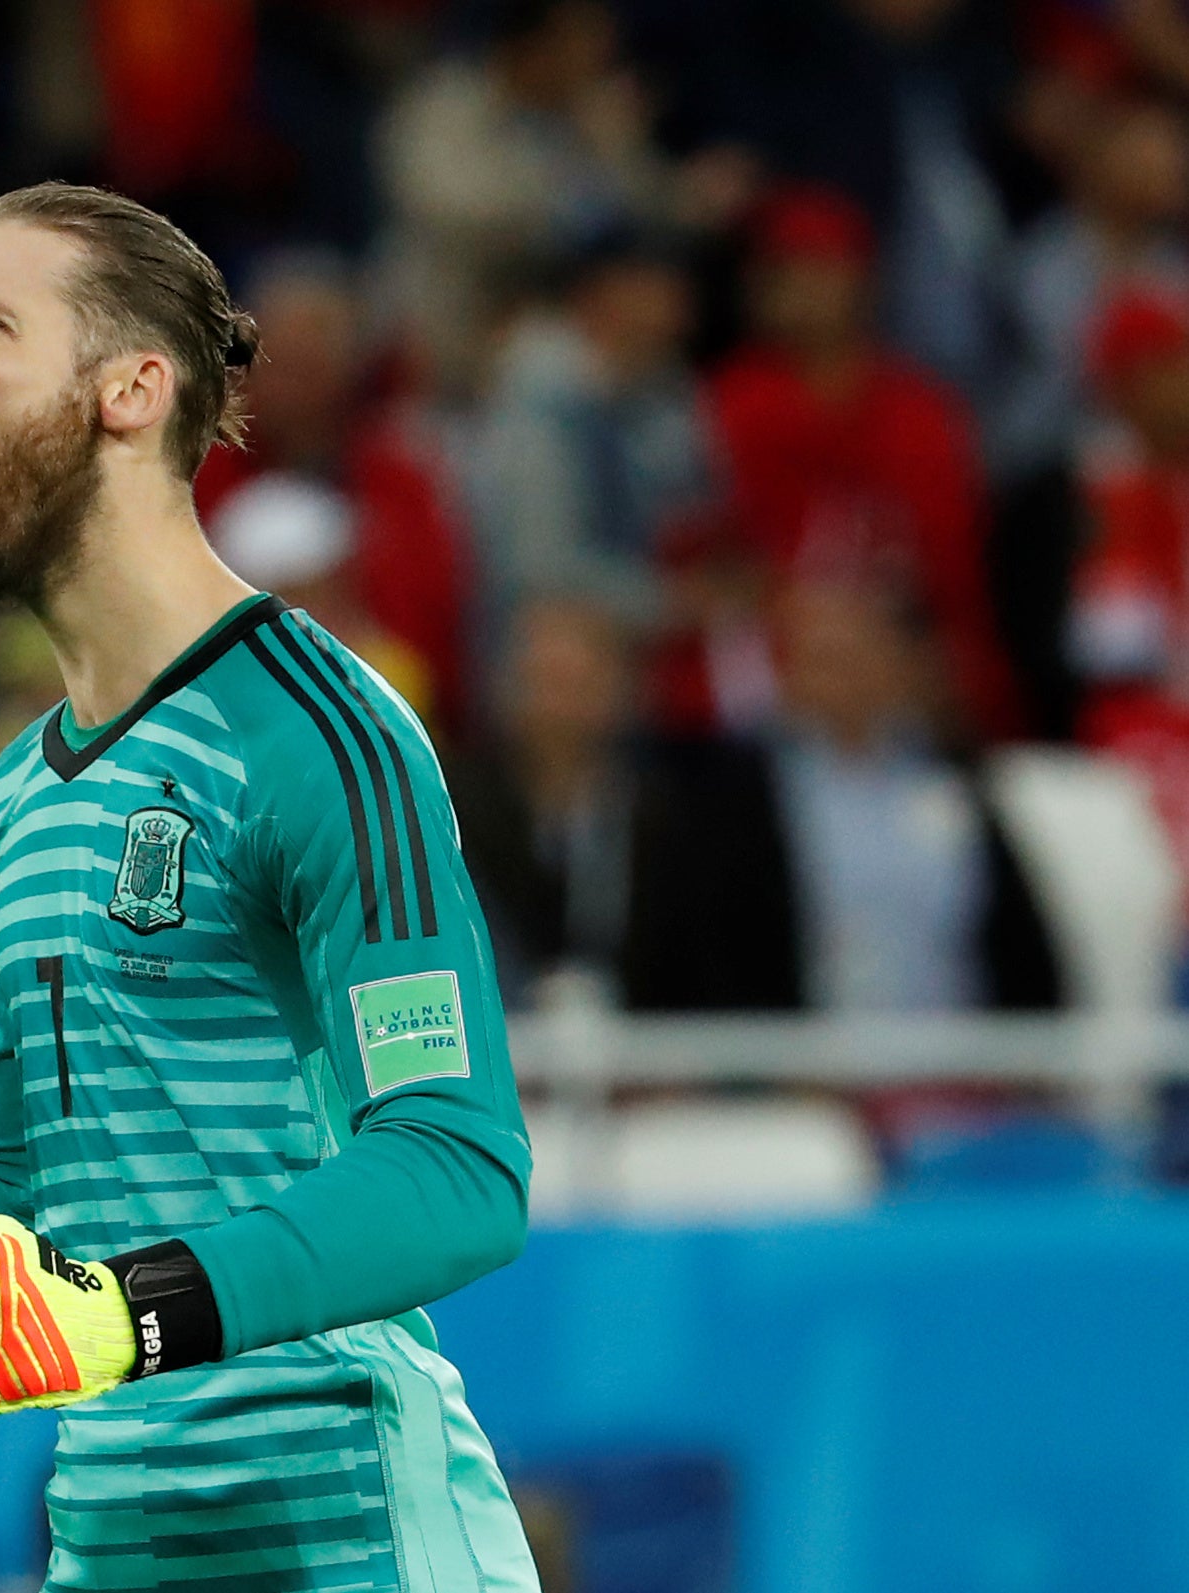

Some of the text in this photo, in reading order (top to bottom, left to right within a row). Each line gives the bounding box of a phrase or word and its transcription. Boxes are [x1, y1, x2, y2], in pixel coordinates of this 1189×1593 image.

[36, 955, 73, 1117] 1
[364, 1003, 452, 1028] LIVING
[423, 1037, 456, 1049] FIFA
[139, 1310, 162, 1376] DE GEA
